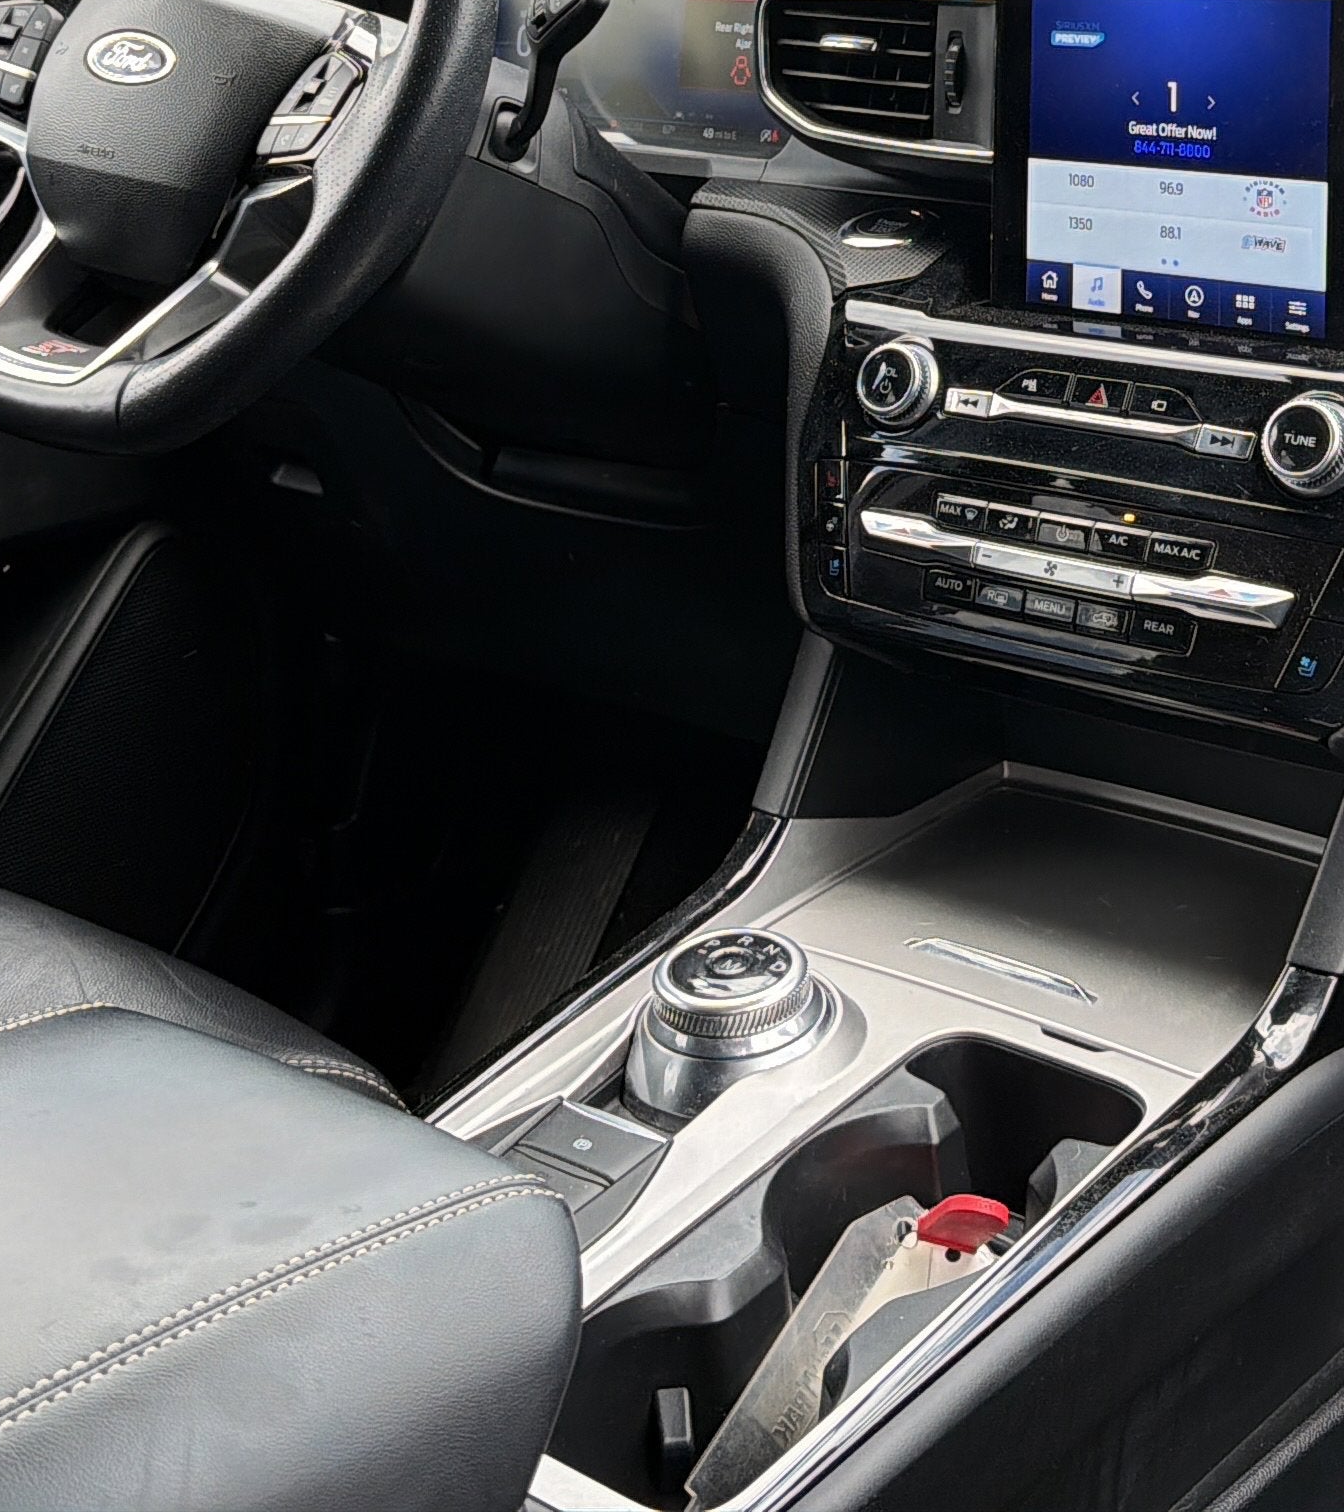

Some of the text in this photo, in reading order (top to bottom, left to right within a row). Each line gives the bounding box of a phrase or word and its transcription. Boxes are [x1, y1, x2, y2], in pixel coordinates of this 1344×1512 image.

[715, 21, 733, 33] Rear
[101, 40, 153, 72] Ford
[1167, 81, 1178, 112] 1
[702, 128, 714, 139] 49
[1128, 120, 1216, 140] Great Offer Now!
[1069, 173, 1184, 196] 1080 96.9
[1069, 216, 1182, 240] 1350 88.1
[1237, 316, 1253, 326] Apps
[1284, 433, 1317, 448] TUNE
[940, 502, 961, 516] MAX
[1108, 533, 1129, 547] A/C
[1154, 541, 1202, 561] MAX A/C
[935, 576, 964, 592] AUTO
[1034, 598, 1066, 615] MENU
[1143, 619, 1175, 636] REAR
[737, 935, 754, 947] R
[762, 944, 781, 956] N
[769, 960, 787, 972] D
